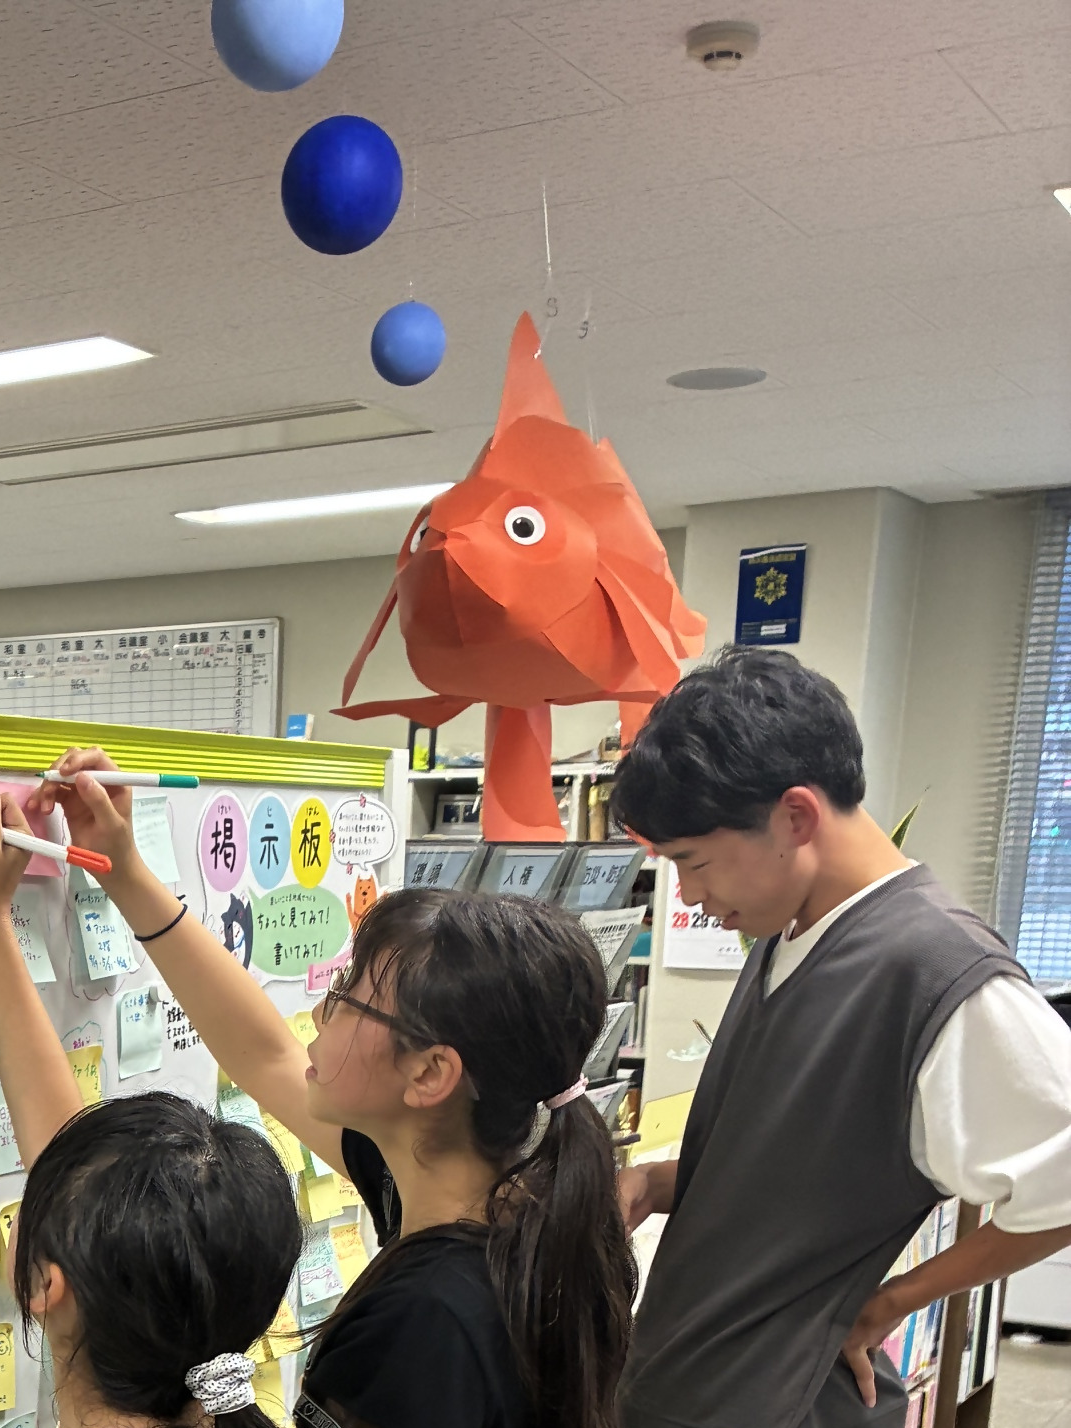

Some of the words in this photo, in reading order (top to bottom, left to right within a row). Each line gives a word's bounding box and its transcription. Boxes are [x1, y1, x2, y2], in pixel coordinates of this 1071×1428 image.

[257, 905, 331, 931] ちょっと見てみて!
[672, 912, 689, 929] 28
[274, 939, 324, 967] 書いてみて!
